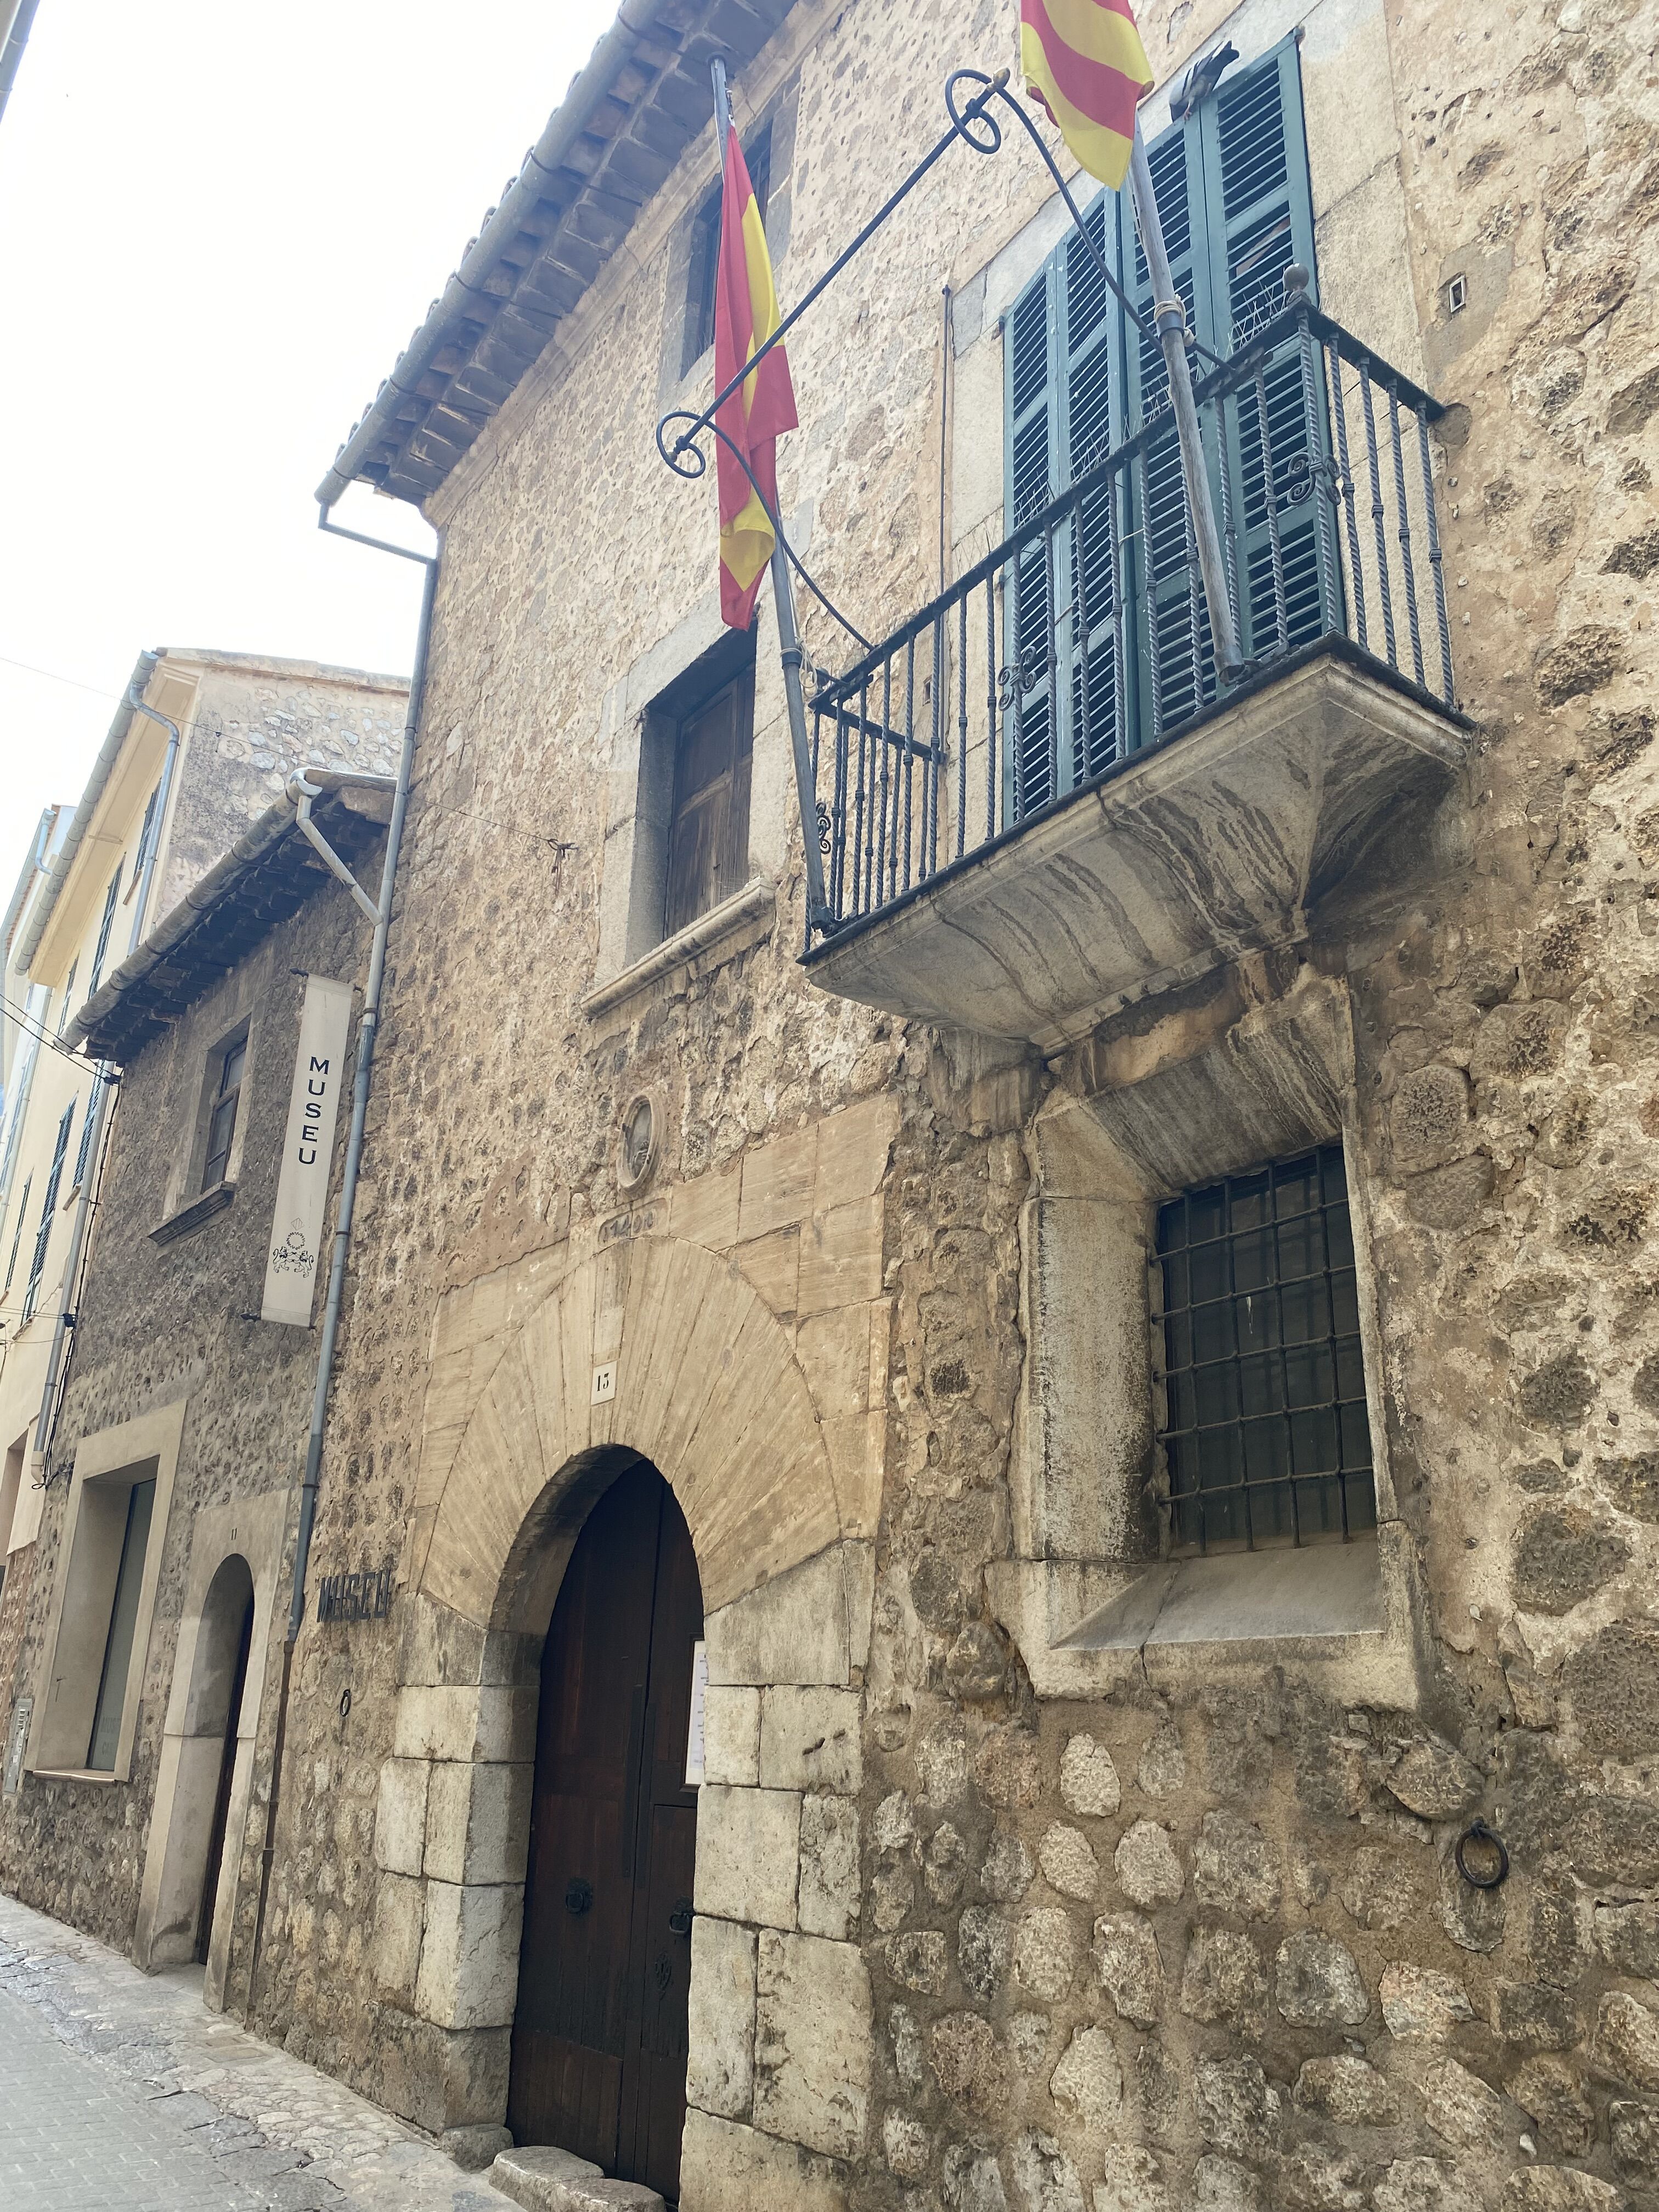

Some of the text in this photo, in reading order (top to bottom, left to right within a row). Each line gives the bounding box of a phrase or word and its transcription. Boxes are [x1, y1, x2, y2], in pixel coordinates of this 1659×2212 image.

[298, 1056, 329, 1165] MUSEU
[597, 1372, 609, 1391] 13
[317, 1570, 391, 1623] MUSEU
